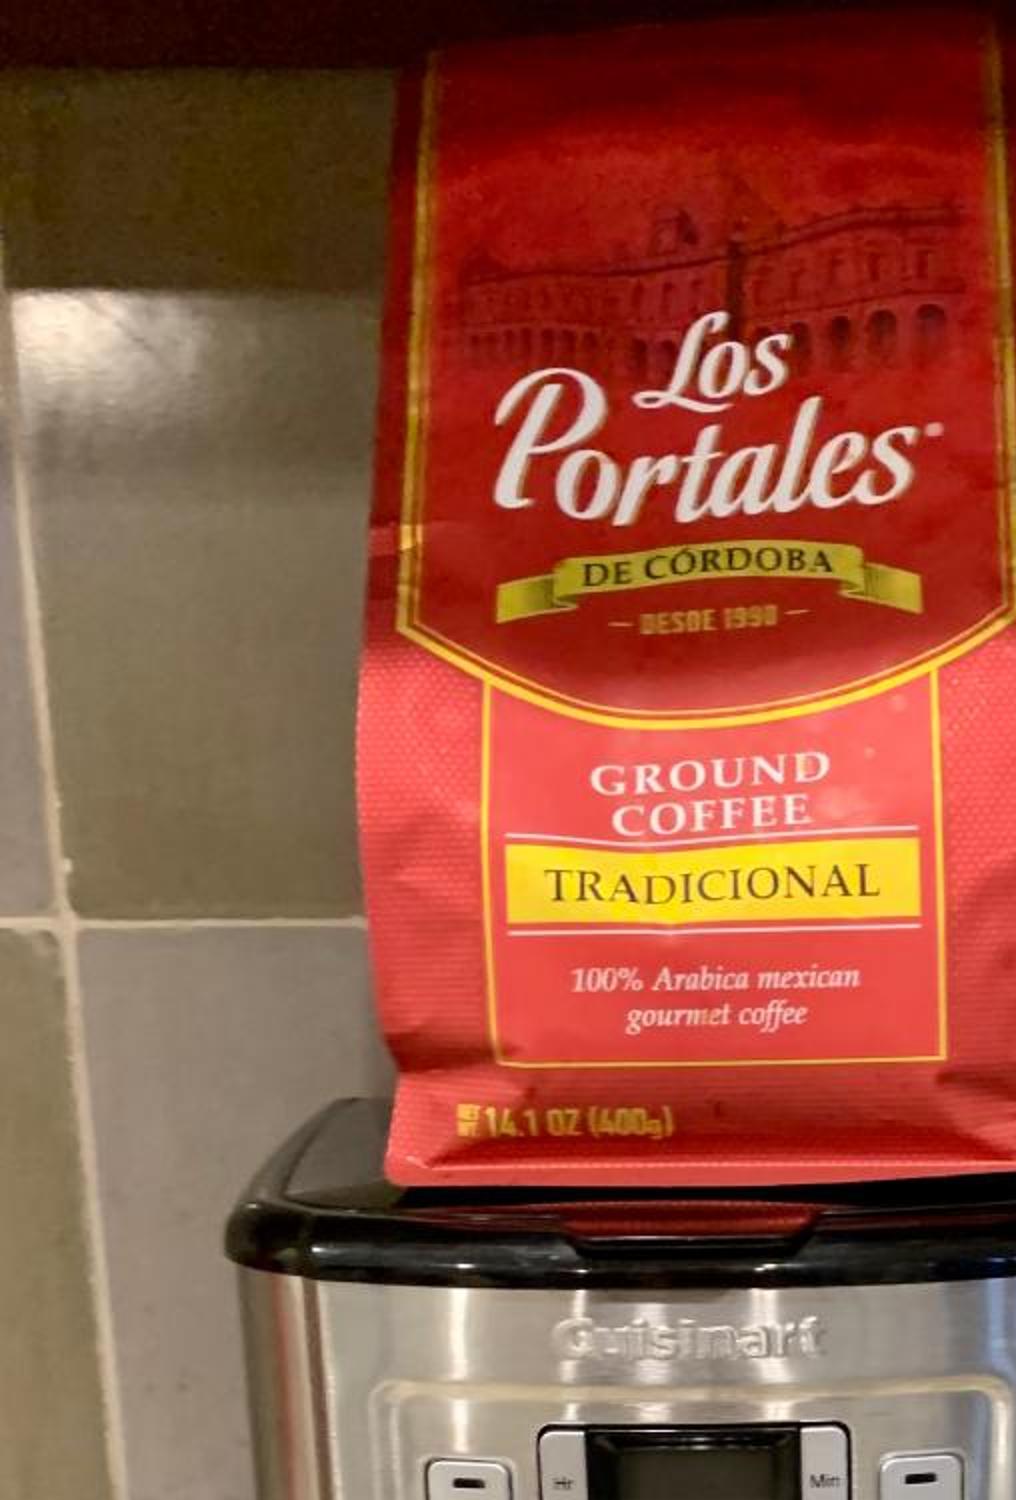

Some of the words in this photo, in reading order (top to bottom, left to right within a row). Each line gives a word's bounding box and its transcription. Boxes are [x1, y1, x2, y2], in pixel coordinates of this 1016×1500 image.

[633, 311, 793, 414] Los
[583, 561, 633, 588] DE
[644, 544, 834, 580] CÓRDOBA
[640, 608, 715, 635] DESDE
[590, 751, 831, 798] GROUND
[612, 794, 813, 837] COFFEE
[544, 863, 881, 906] TRADICIONAL
[570, 967, 643, 994] 100%
[651, 966, 749, 992] Arabica
[757, 965, 860, 988] mexican
[625, 1003, 730, 1036] gourmet
[739, 1001, 807, 1030] coffee
[485, 1106, 539, 1137] 14.1
[547, 1109, 582, 1136] OZ
[553, 1316, 828, 1360] Cuisinart
[552, 1475, 574, 1490] Hr
[810, 1474, 840, 1488] Min
